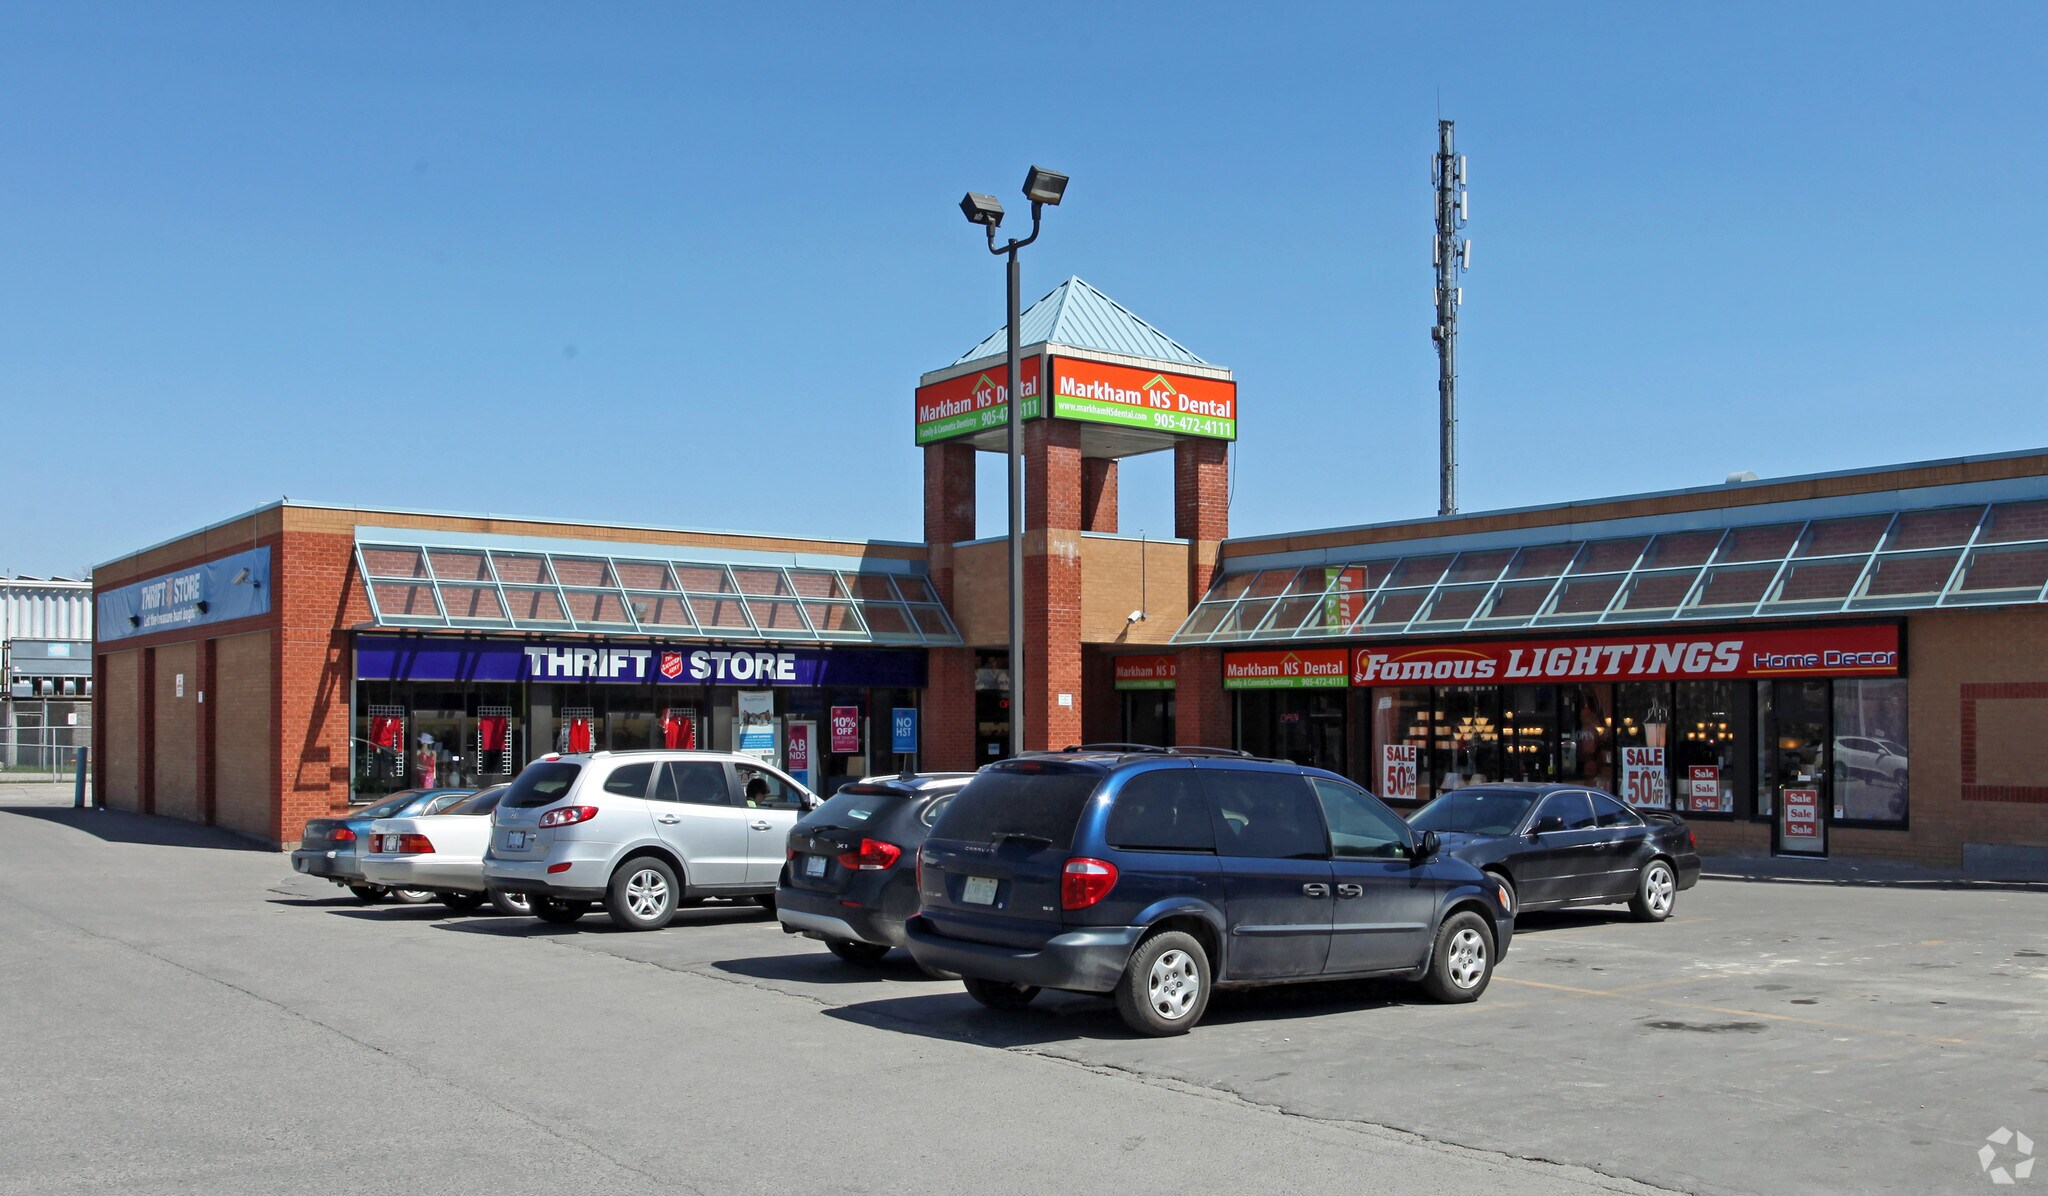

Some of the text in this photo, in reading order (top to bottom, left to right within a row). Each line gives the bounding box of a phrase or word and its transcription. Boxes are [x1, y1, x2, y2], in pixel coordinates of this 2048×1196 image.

[920, 376, 1037, 423] Markham NS Dtal
[1060, 376, 1231, 418] Markham NS Dental
[1058, 401, 1148, 422] www.markhamNSdental.com
[1154, 413, 1231, 436] 905-472-4111
[141, 572, 201, 610] THRIFT STORE
[524, 647, 796, 680] THRIFT STORE
[1362, 640, 1896, 681] Famous LIGHTINGS Home Decor
[1116, 665, 1153, 677] Markham
[1156, 663, 1167, 675] NS
[1227, 660, 1343, 676] Markham NS Dental
[1227, 678, 1242, 688] Family
[1247, 678, 1269, 687] Cosmetic
[1269, 677, 1294, 687] Dentistry
[1301, 677, 1344, 687] 905-472-4111
[833, 717, 856, 728] 10%
[896, 718, 912, 728] NO
[1280, 713, 1300, 723] OPEN
[836, 727, 853, 735] OFF
[896, 727, 912, 737] HST
[1387, 746, 1415, 762] SALE
[1626, 748, 1663, 766] SALE
[1387, 766, 1415, 795] 50%
[1694, 769, 1714, 778] Sale
[1406, 782, 1415, 796] OFF
[1628, 770, 1664, 804] 50%
[1695, 783, 1715, 793] Sale
[1653, 788, 1664, 805] OFF
[1695, 799, 1716, 808] Sale
[1790, 793, 1812, 803] Sale
[1791, 809, 1812, 818] Sale
[1791, 825, 1813, 834] Sale
